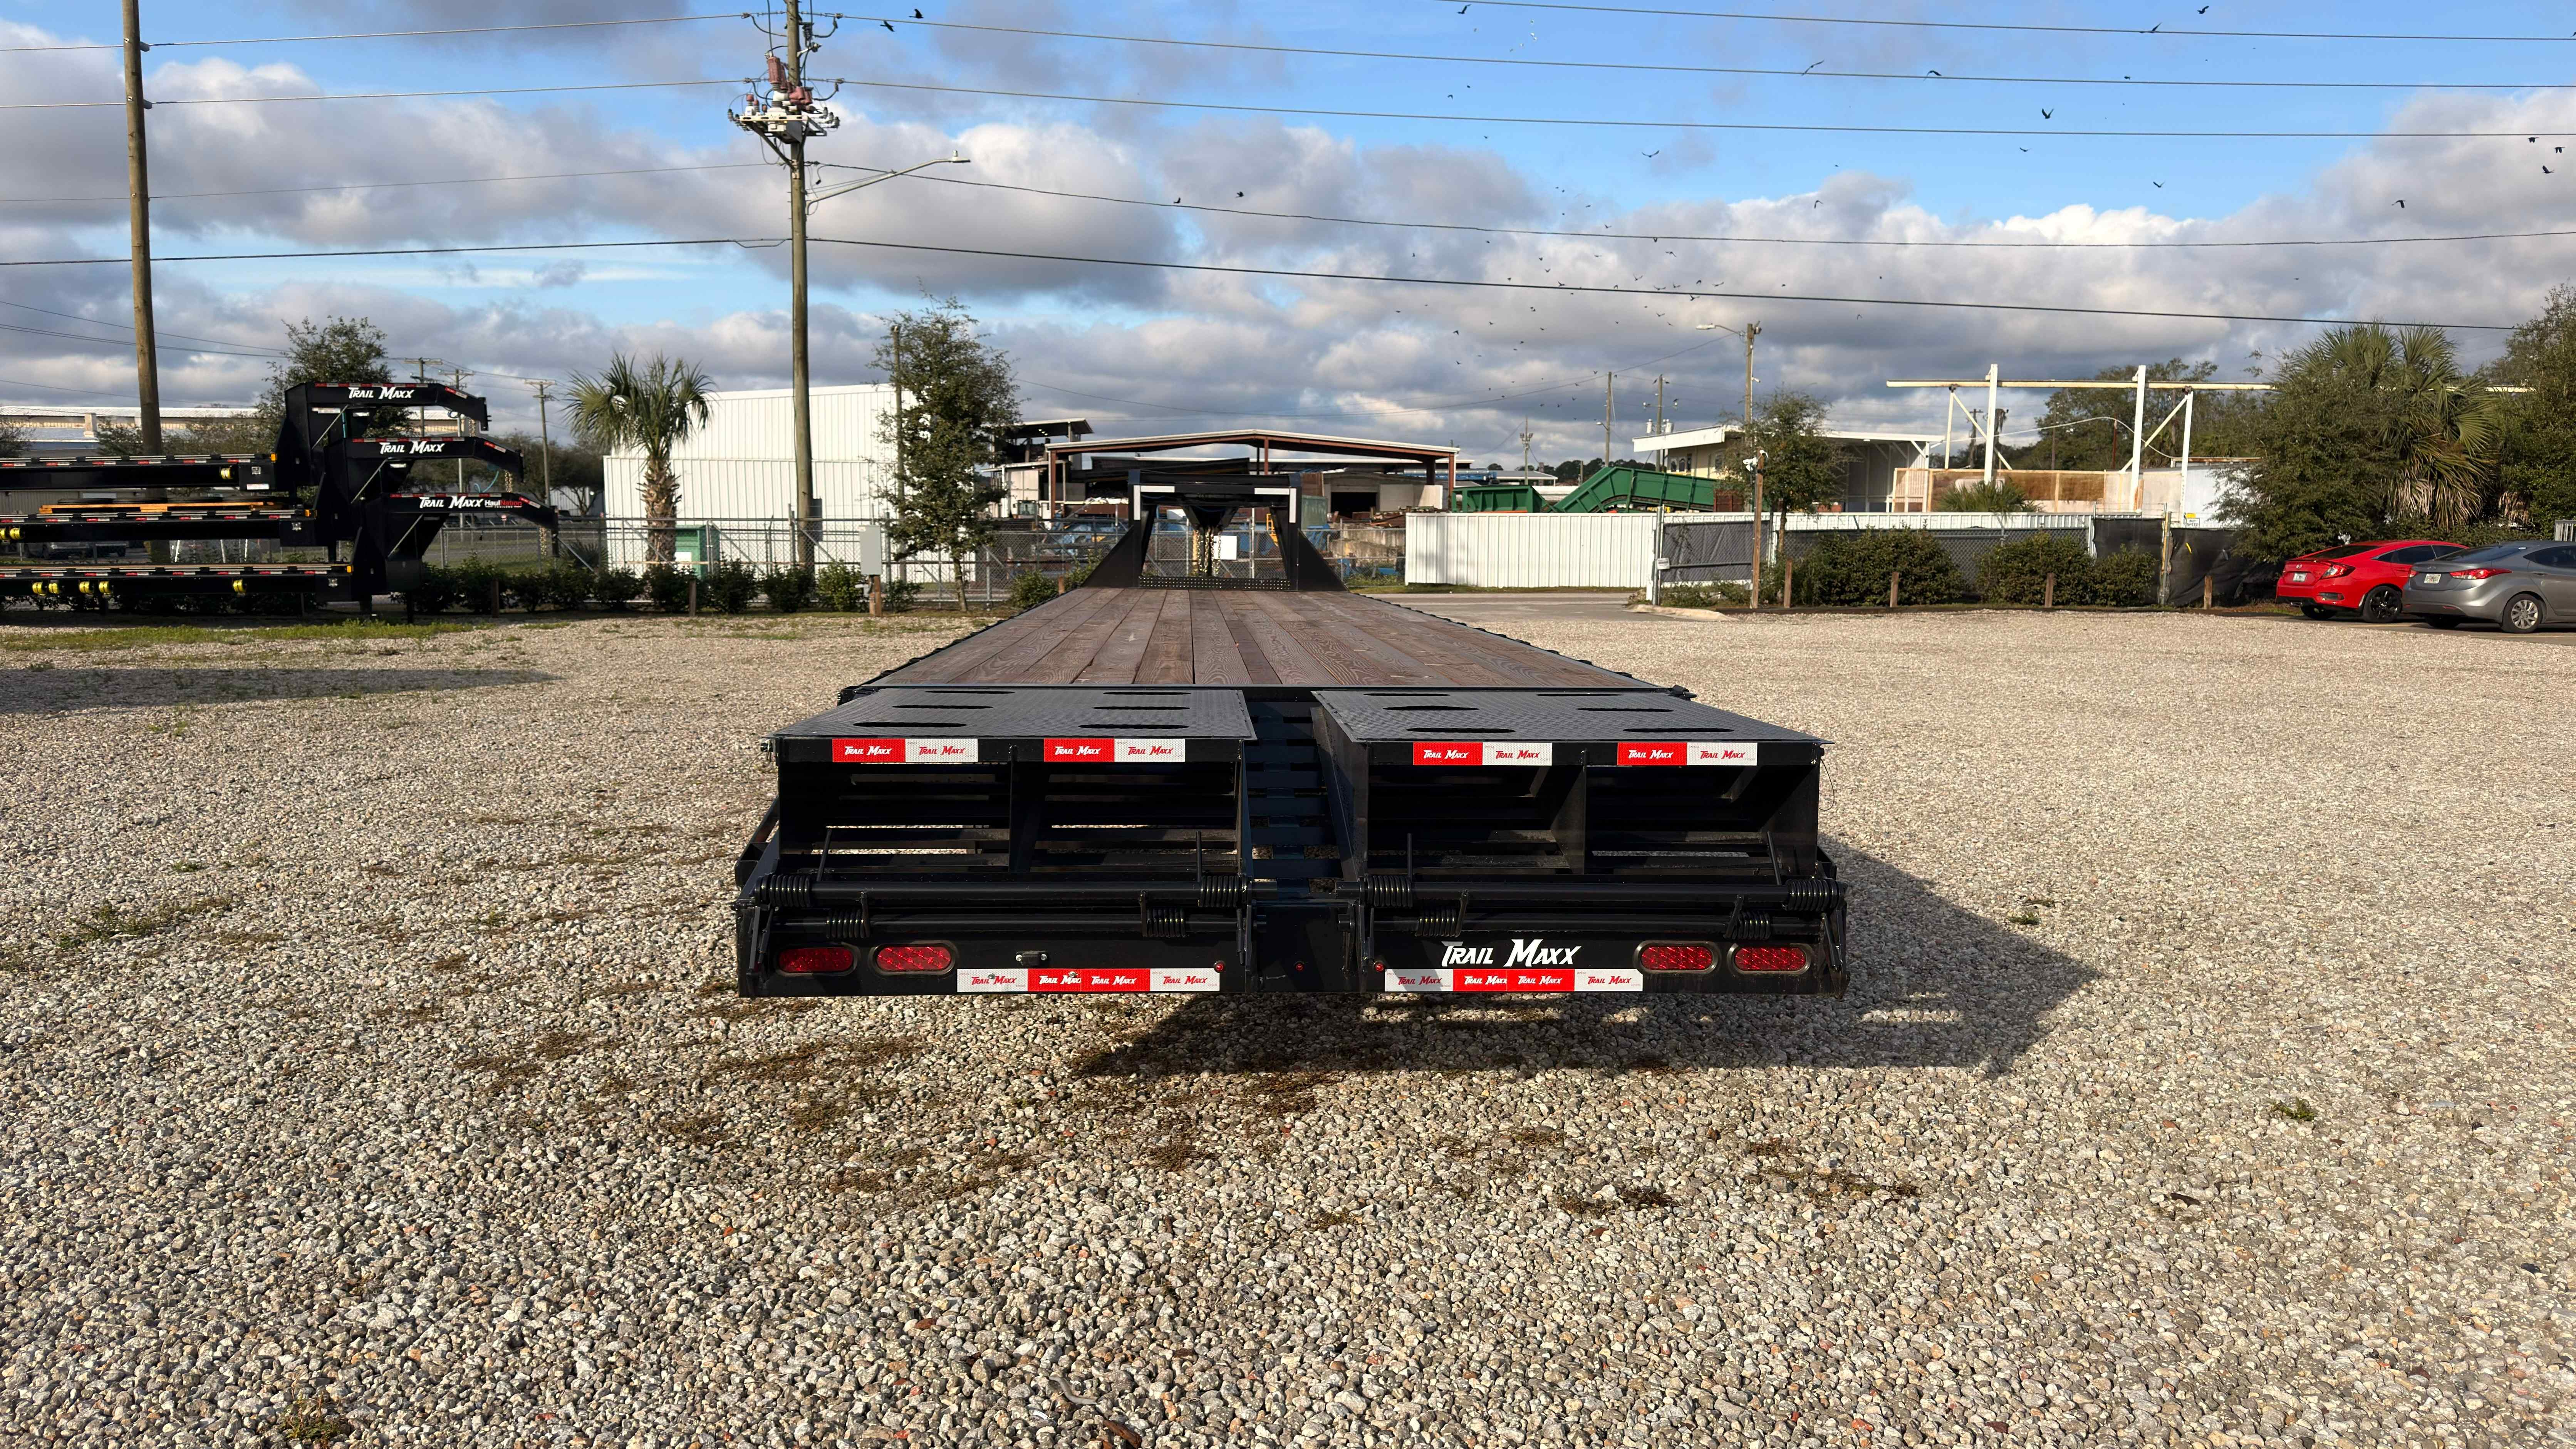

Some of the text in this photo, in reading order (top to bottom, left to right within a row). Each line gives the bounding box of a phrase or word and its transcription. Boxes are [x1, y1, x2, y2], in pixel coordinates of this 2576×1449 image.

[348, 387, 414, 399] TRAIL MAXX
[379, 441, 445, 454] TRAIL MAXX
[419, 496, 484, 509] TRAIL MAXX
[844, 746, 892, 756] TRAIL MAXX
[919, 746, 965, 755] TRAIL MAXX
[1055, 746, 1102, 755] TRAIL MAXX
[1128, 746, 1173, 755] TRAIL MAXX
[1423, 750, 1469, 759] TRAIL MAXX
[1496, 750, 1540, 759] TRAIL MAXX
[1628, 750, 1674, 759] TRAIL MAXX
[1700, 750, 1746, 759] TRAIL MAXX
[1441, 939, 1581, 967] TRAIL MAXX
[971, 975, 1017, 985] TRAIL MAXX
[1039, 975, 1058, 984] TRAIL
[1091, 976, 1137, 985] TRAIL MAXX
[1163, 976, 1208, 984] TRAIL MAXX
[1398, 976, 1442, 985] TRAIL MAXX
[1464, 976, 1483, 985] TRAIL
[1518, 976, 1563, 985] TRAIL MAXX
[1587, 976, 1632, 984] TRAIL MAXX
